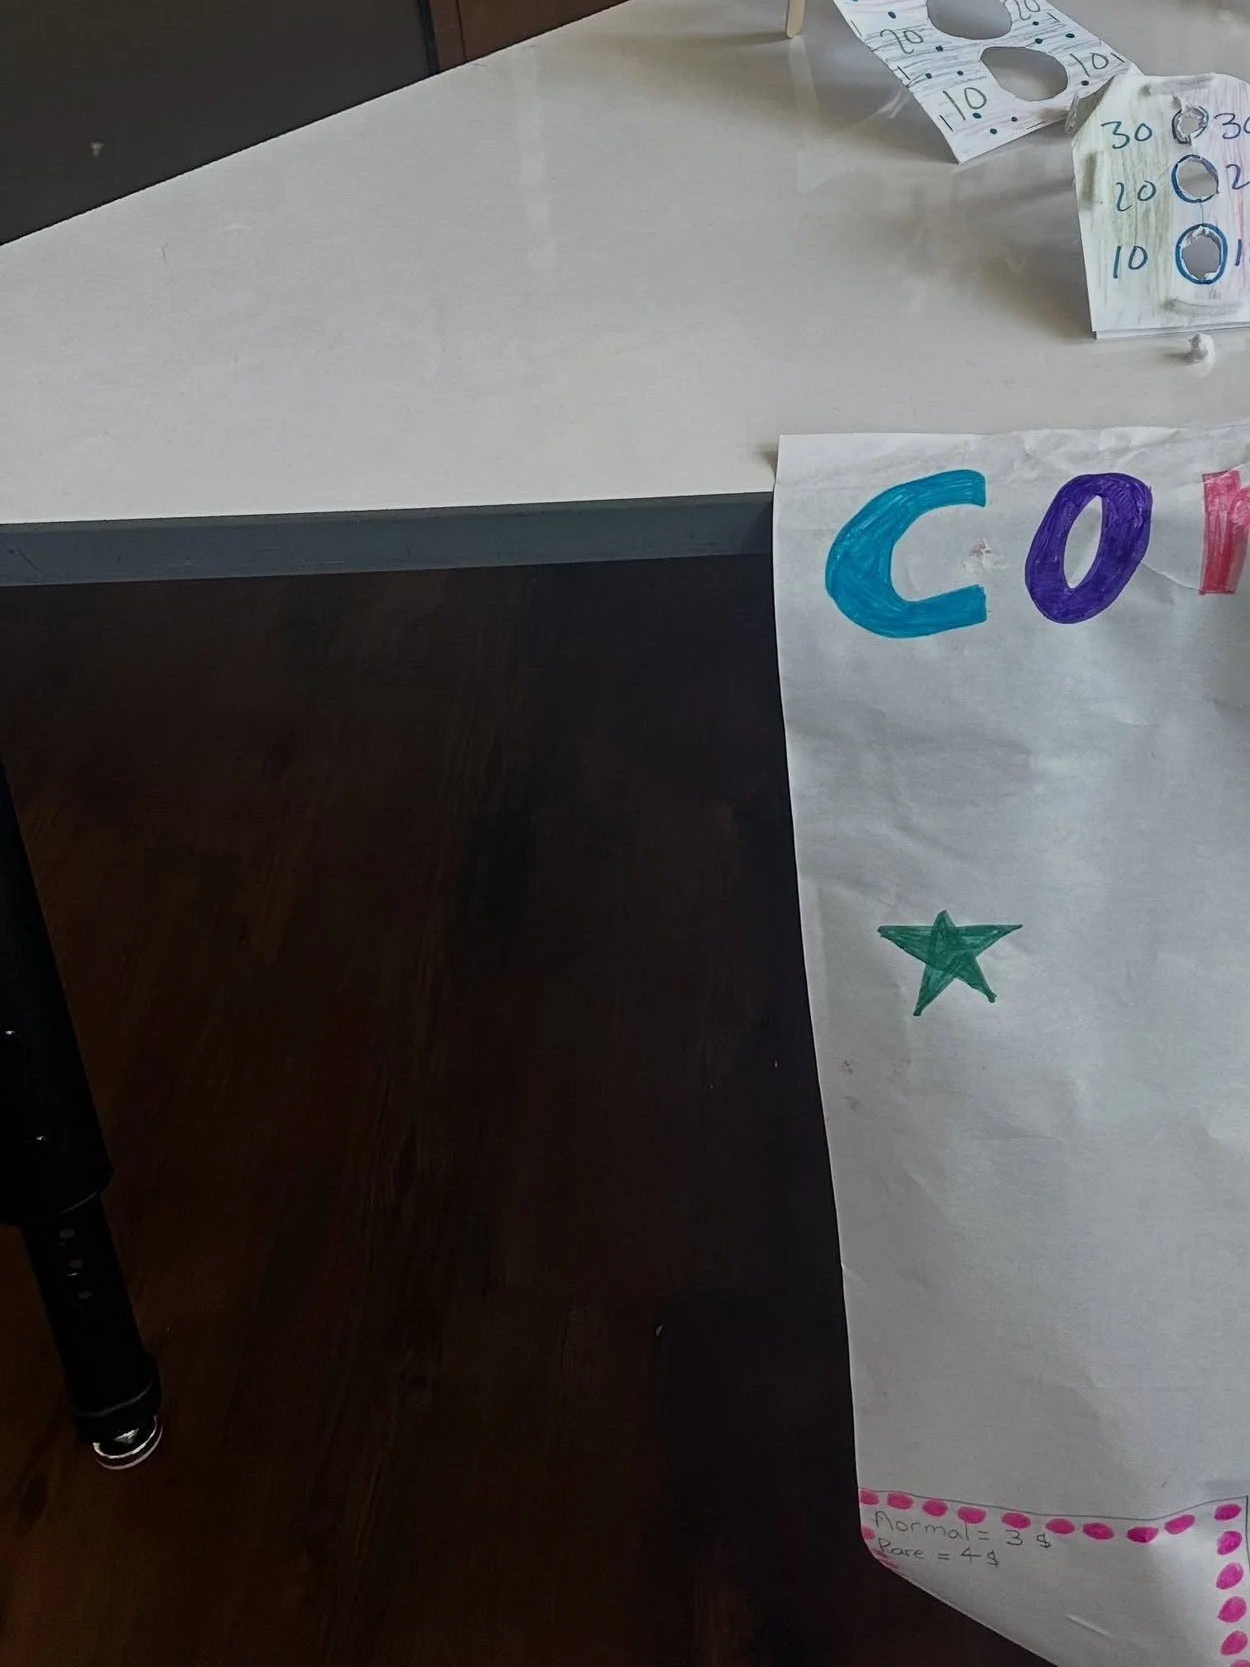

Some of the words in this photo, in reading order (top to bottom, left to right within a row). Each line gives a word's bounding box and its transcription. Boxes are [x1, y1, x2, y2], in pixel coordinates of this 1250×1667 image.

[879, 28, 924, 54] 20
[942, 86, 987, 122] 10
[1069, 52, 1109, 78] 10
[1100, 120, 1153, 150] 30
[1115, 180, 1157, 212] 20
[1112, 245, 1148, 279] 10
[1005, 1529, 1024, 1547] 3
[1034, 1533, 1052, 1549] $
